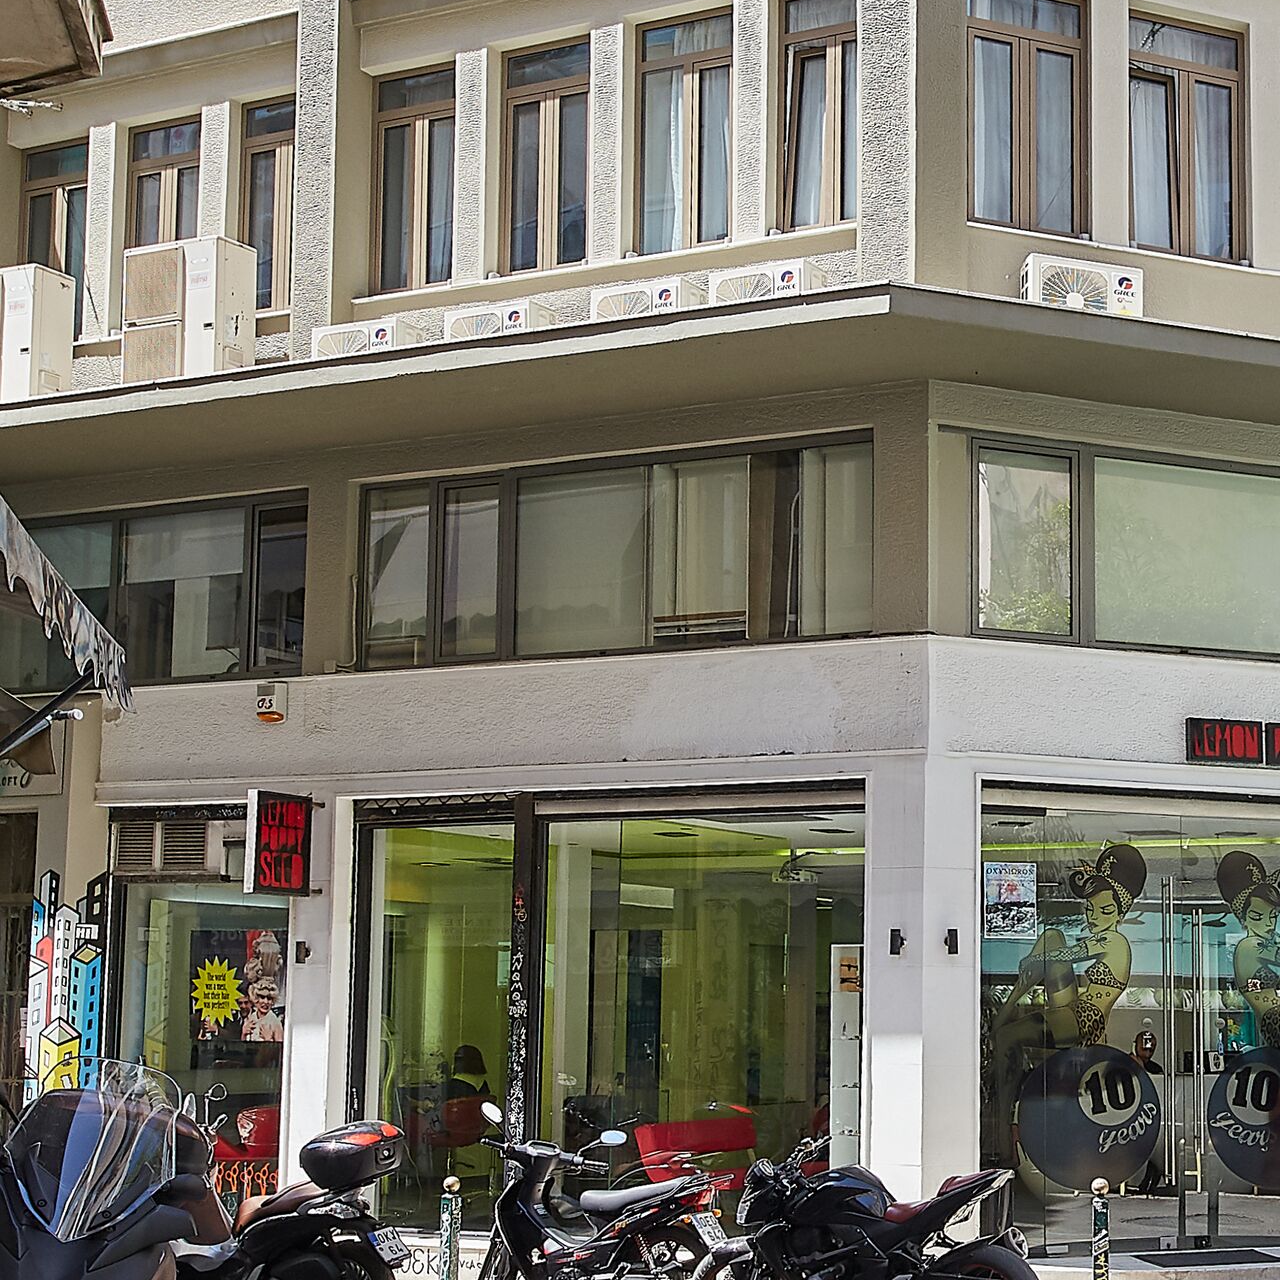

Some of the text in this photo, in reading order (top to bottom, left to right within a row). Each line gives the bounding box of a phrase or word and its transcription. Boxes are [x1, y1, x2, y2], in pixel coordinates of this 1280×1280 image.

[1194, 723, 1259, 759] LEMON
[261, 799, 306, 828] LEMON
[260, 825, 304, 853] POPPY
[259, 851, 304, 889] SEED
[1085, 1067, 1136, 1115] 10
[1232, 1066, 1280, 1112] 10
[1098, 1102, 1157, 1153] years
